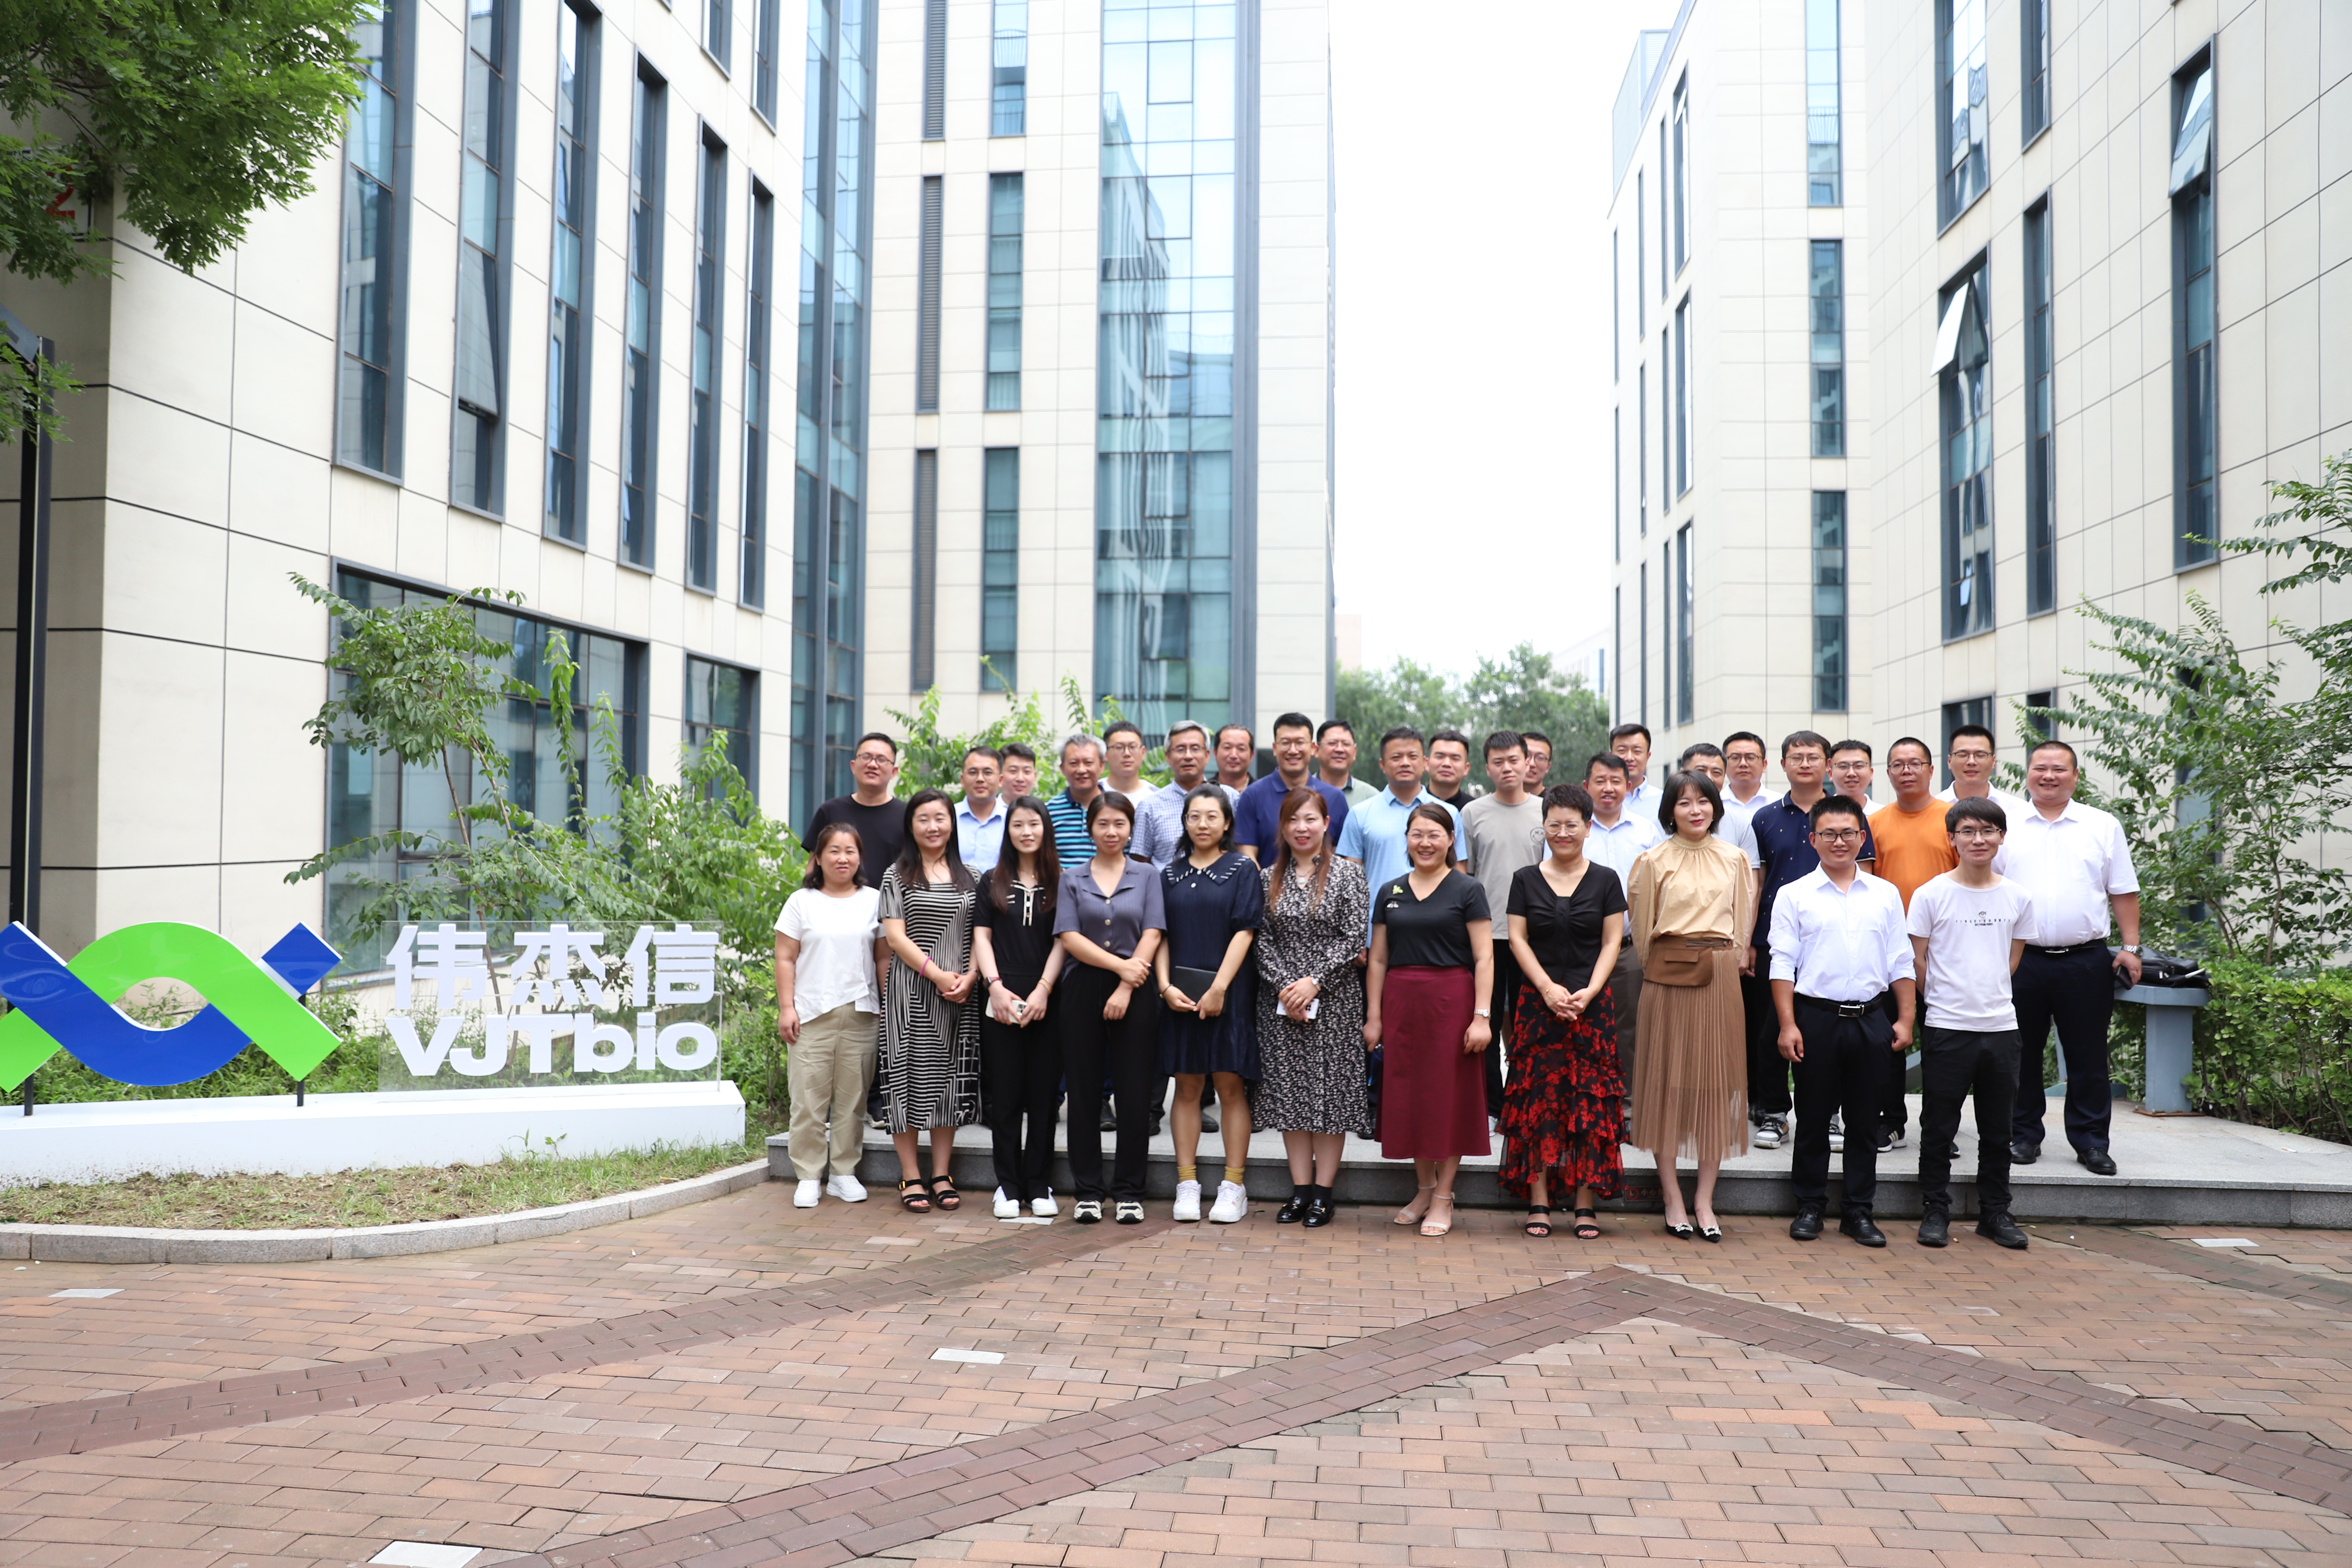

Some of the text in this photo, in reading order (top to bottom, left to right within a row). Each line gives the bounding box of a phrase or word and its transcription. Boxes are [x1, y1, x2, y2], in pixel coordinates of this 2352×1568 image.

[386, 923, 719, 1009] 伟杰信
[384, 1012, 718, 1076] VJTbio
